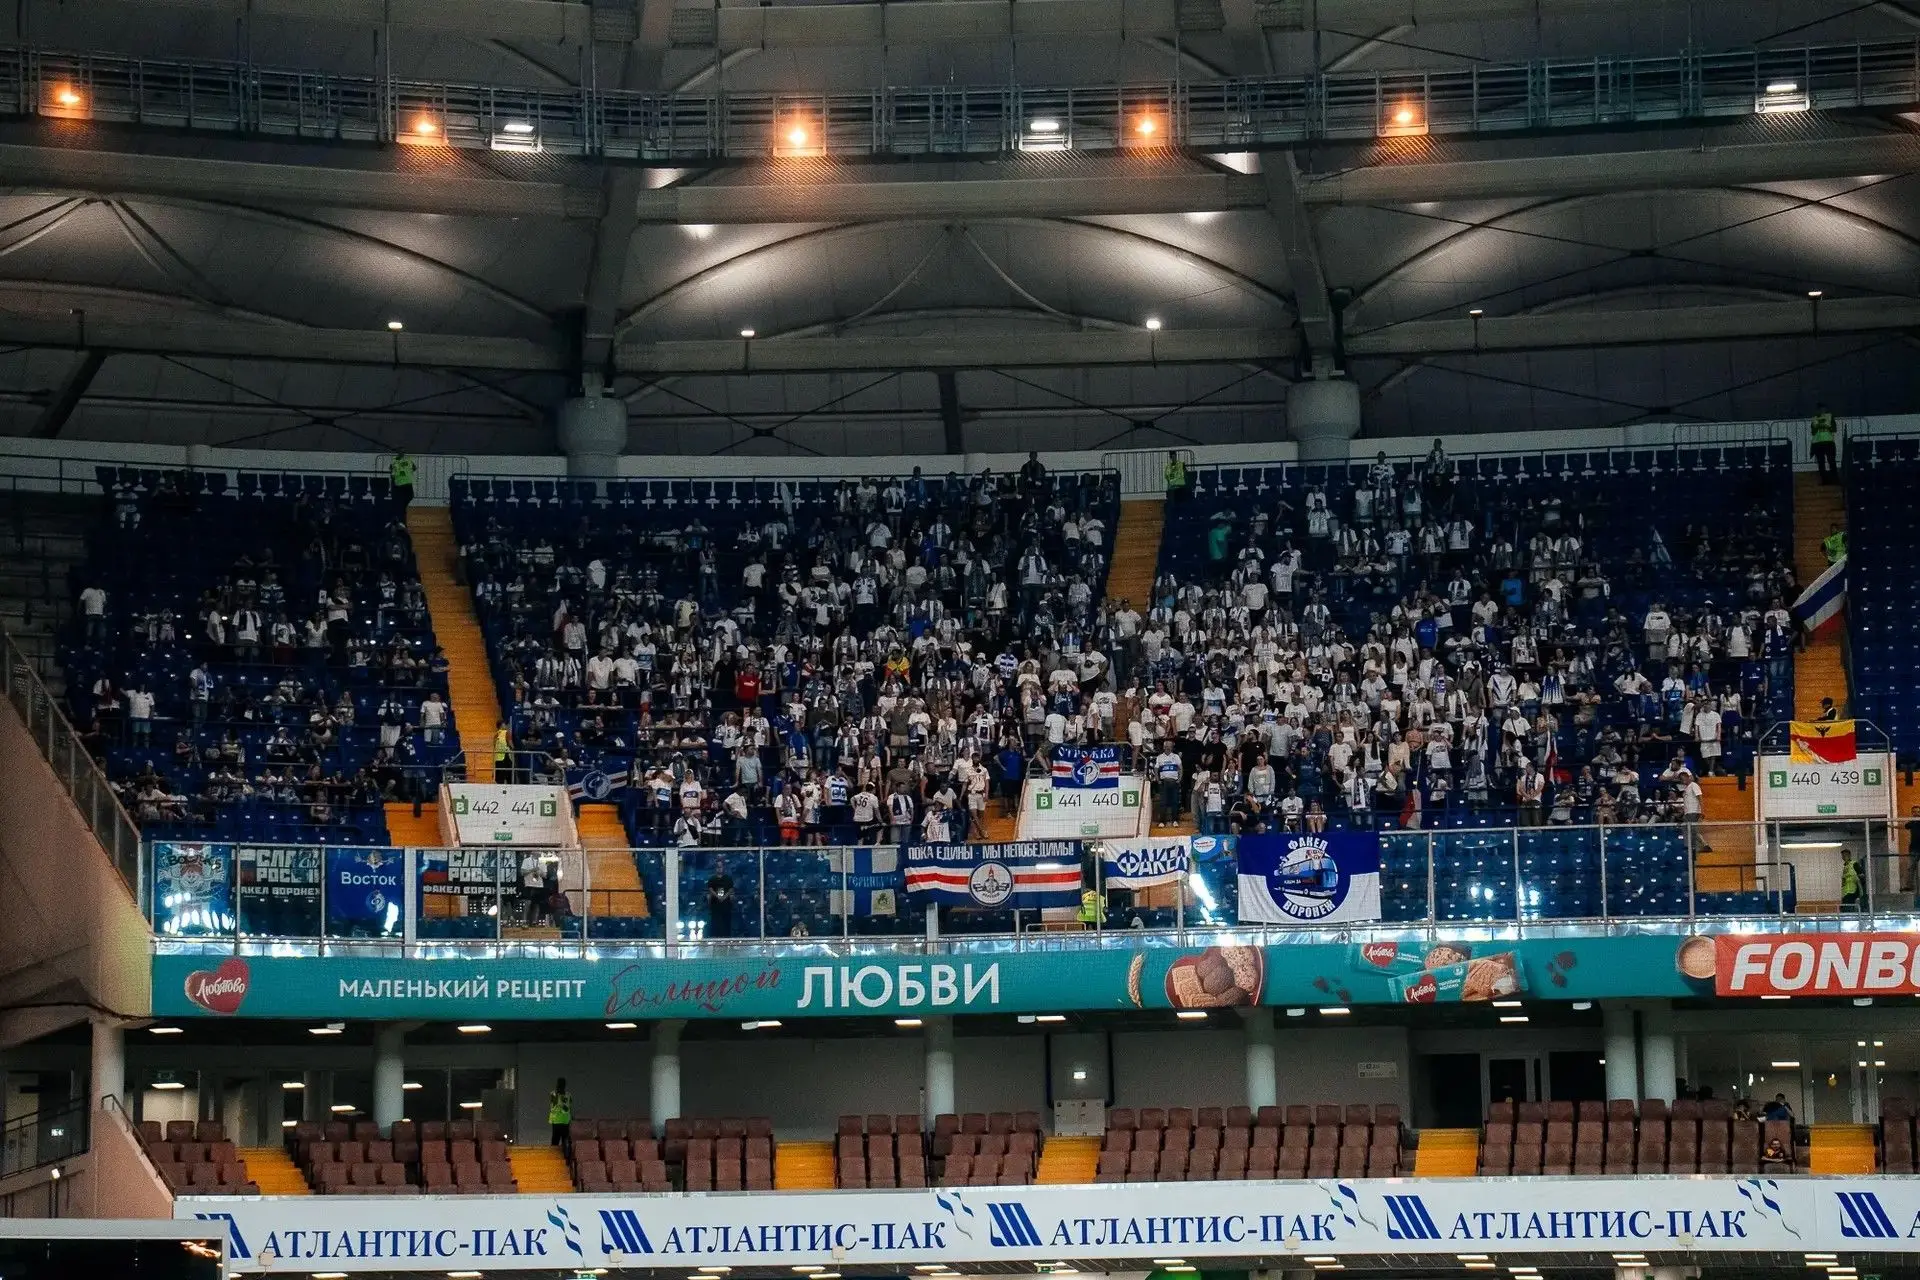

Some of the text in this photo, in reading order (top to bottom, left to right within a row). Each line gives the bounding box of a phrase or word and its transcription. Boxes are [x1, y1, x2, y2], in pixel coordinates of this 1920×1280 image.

[1791, 771, 1820, 785] 440
[1830, 770, 1859, 785] 439
[472, 801, 499, 814] 442
[512, 801, 535, 815] 441
[1059, 794, 1081, 807] 441
[1092, 792, 1119, 806] 440
[908, 846, 934, 860] ПОКА
[937, 845, 973, 860] ЕДИНЫ
[983, 844, 1000, 859] МЫ
[1287, 836, 1328, 851] ФАКЕЛ
[1117, 845, 1188, 876] ФАКЕЛ
[423, 885, 461, 894] ФАКЕЛ
[1282, 898, 1336, 918] ВОРОНЕЖ
[1730, 941, 1920, 990] FONB
[196, 977, 245, 1004] Любятово
[339, 959, 1000, 1017] МАЛЕНЬКИЙ РЕЦЕПТ большой ЛЮБВИ
[660, 1221, 947, 1254] АТЛАНТИС-ПАК
[1050, 1213, 1336, 1246] АТЛАНТИС-ПАК
[1449, 1209, 1748, 1240] АТЛАНТИС-ПАК
[262, 1228, 548, 1258] АТЛАНТИС-ПАК
